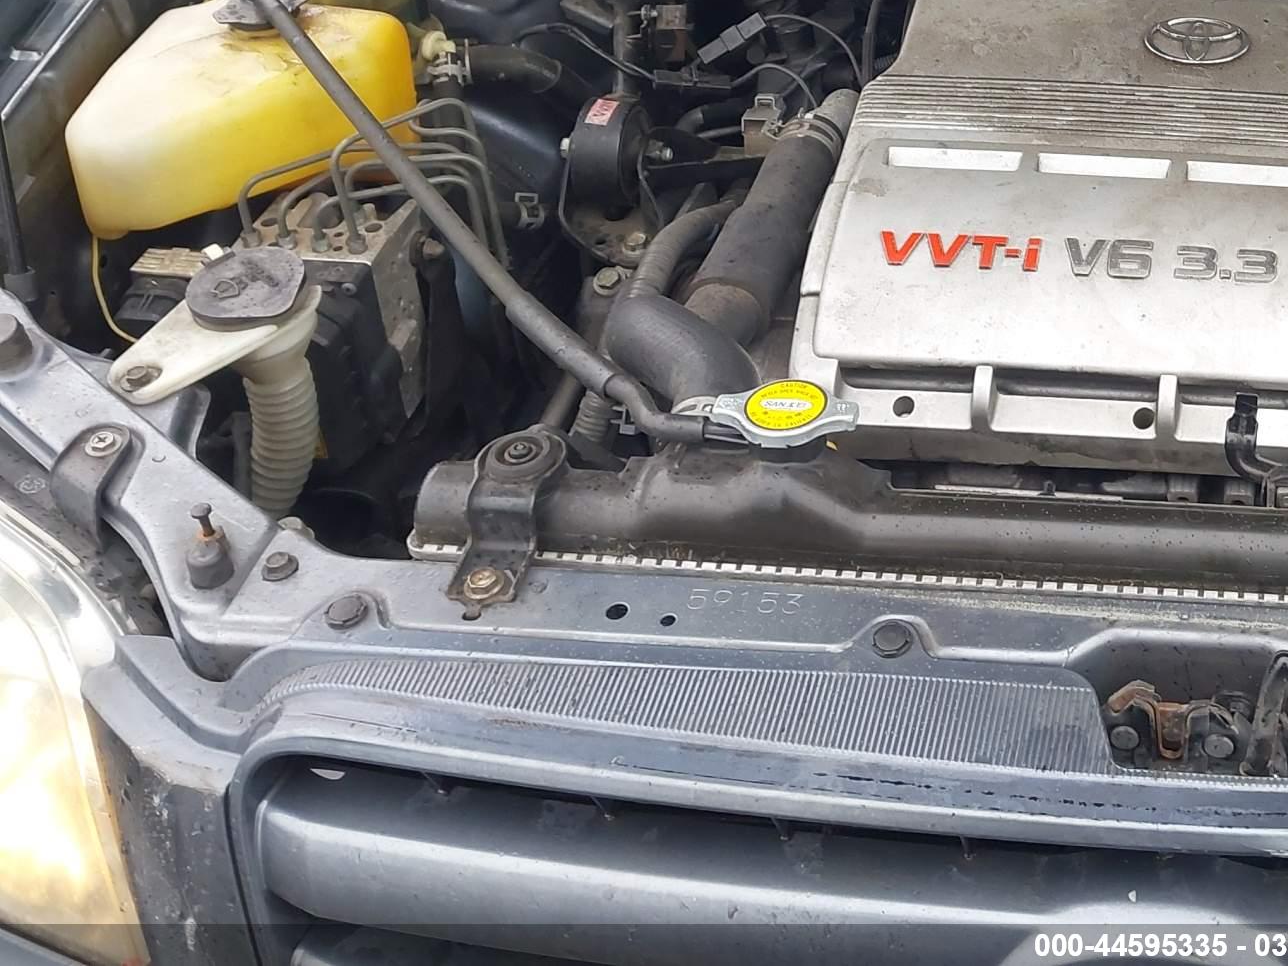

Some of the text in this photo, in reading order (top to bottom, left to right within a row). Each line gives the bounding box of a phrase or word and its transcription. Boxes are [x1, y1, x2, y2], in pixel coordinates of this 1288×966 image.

[880, 230, 1279, 284] VVT-i V6 3.3
[686, 588, 804, 615] 59153
